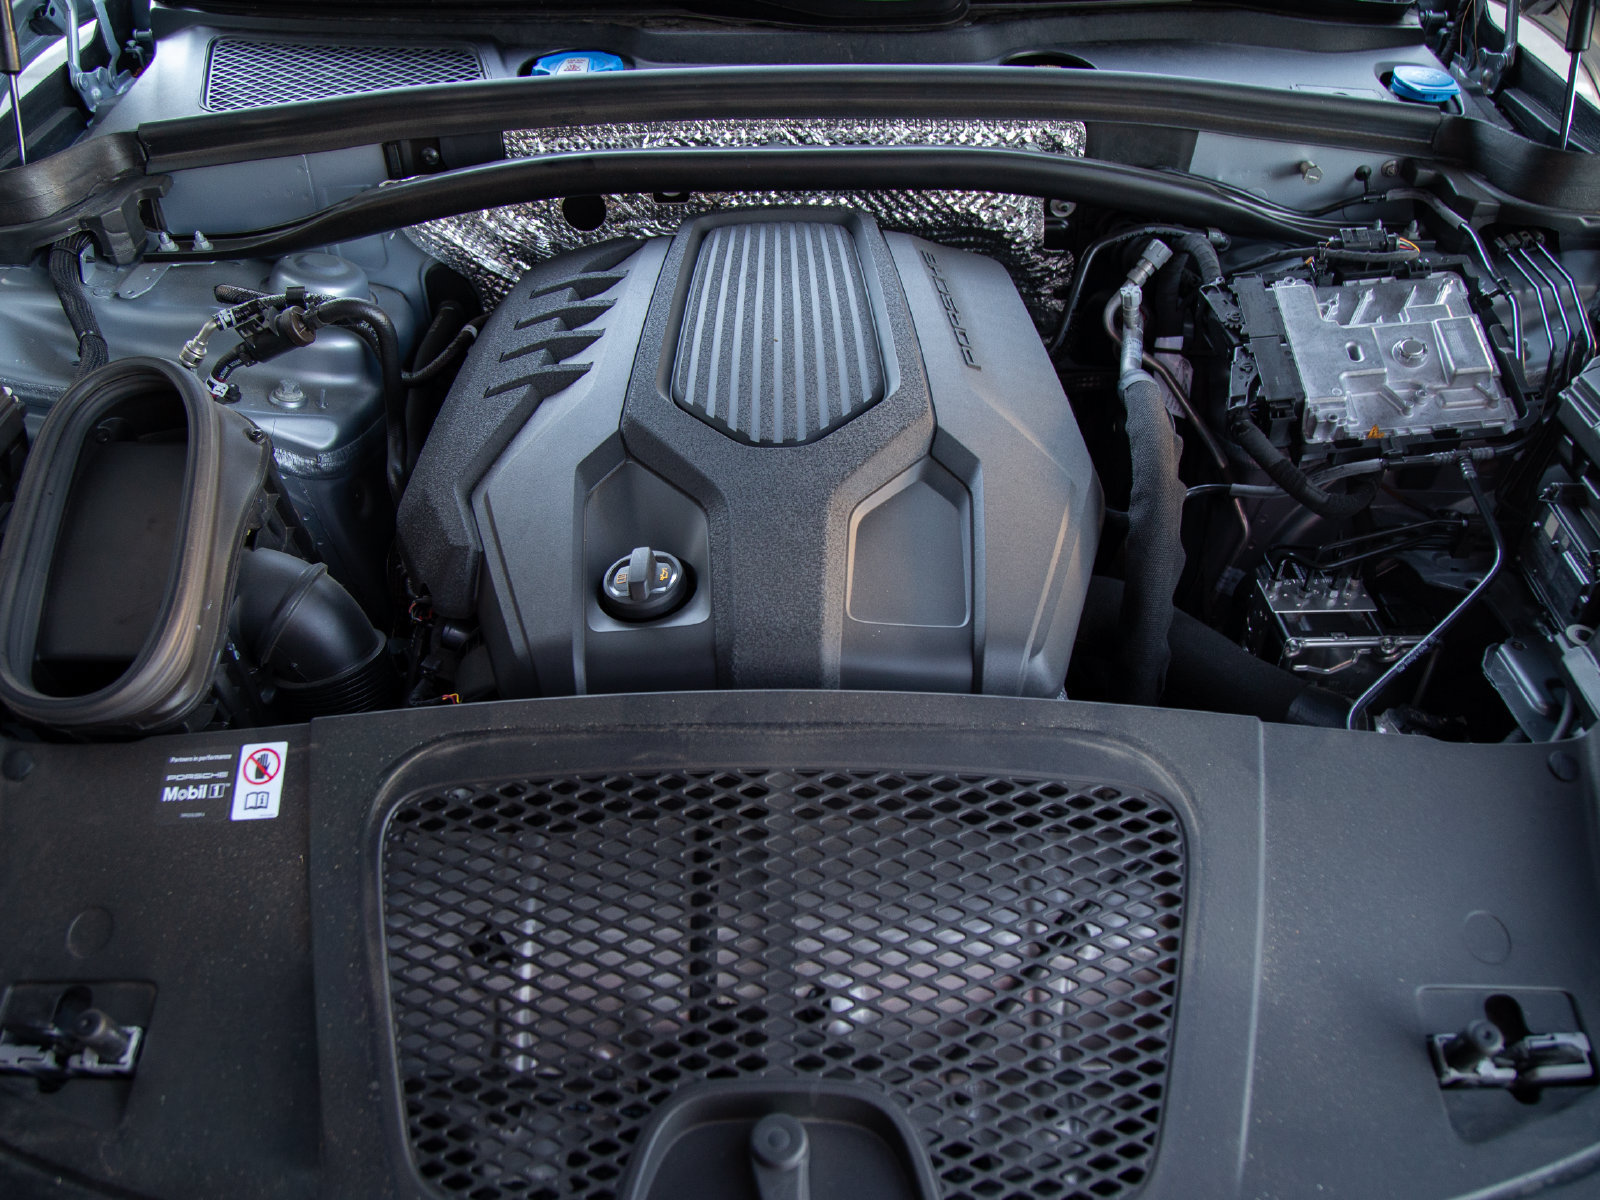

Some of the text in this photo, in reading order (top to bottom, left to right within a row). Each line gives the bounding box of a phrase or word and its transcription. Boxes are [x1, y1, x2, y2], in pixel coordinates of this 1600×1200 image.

[920, 250, 982, 371] PORSCHE
[166, 771, 229, 781] PORSCHE
[163, 784, 208, 802] Mobil
